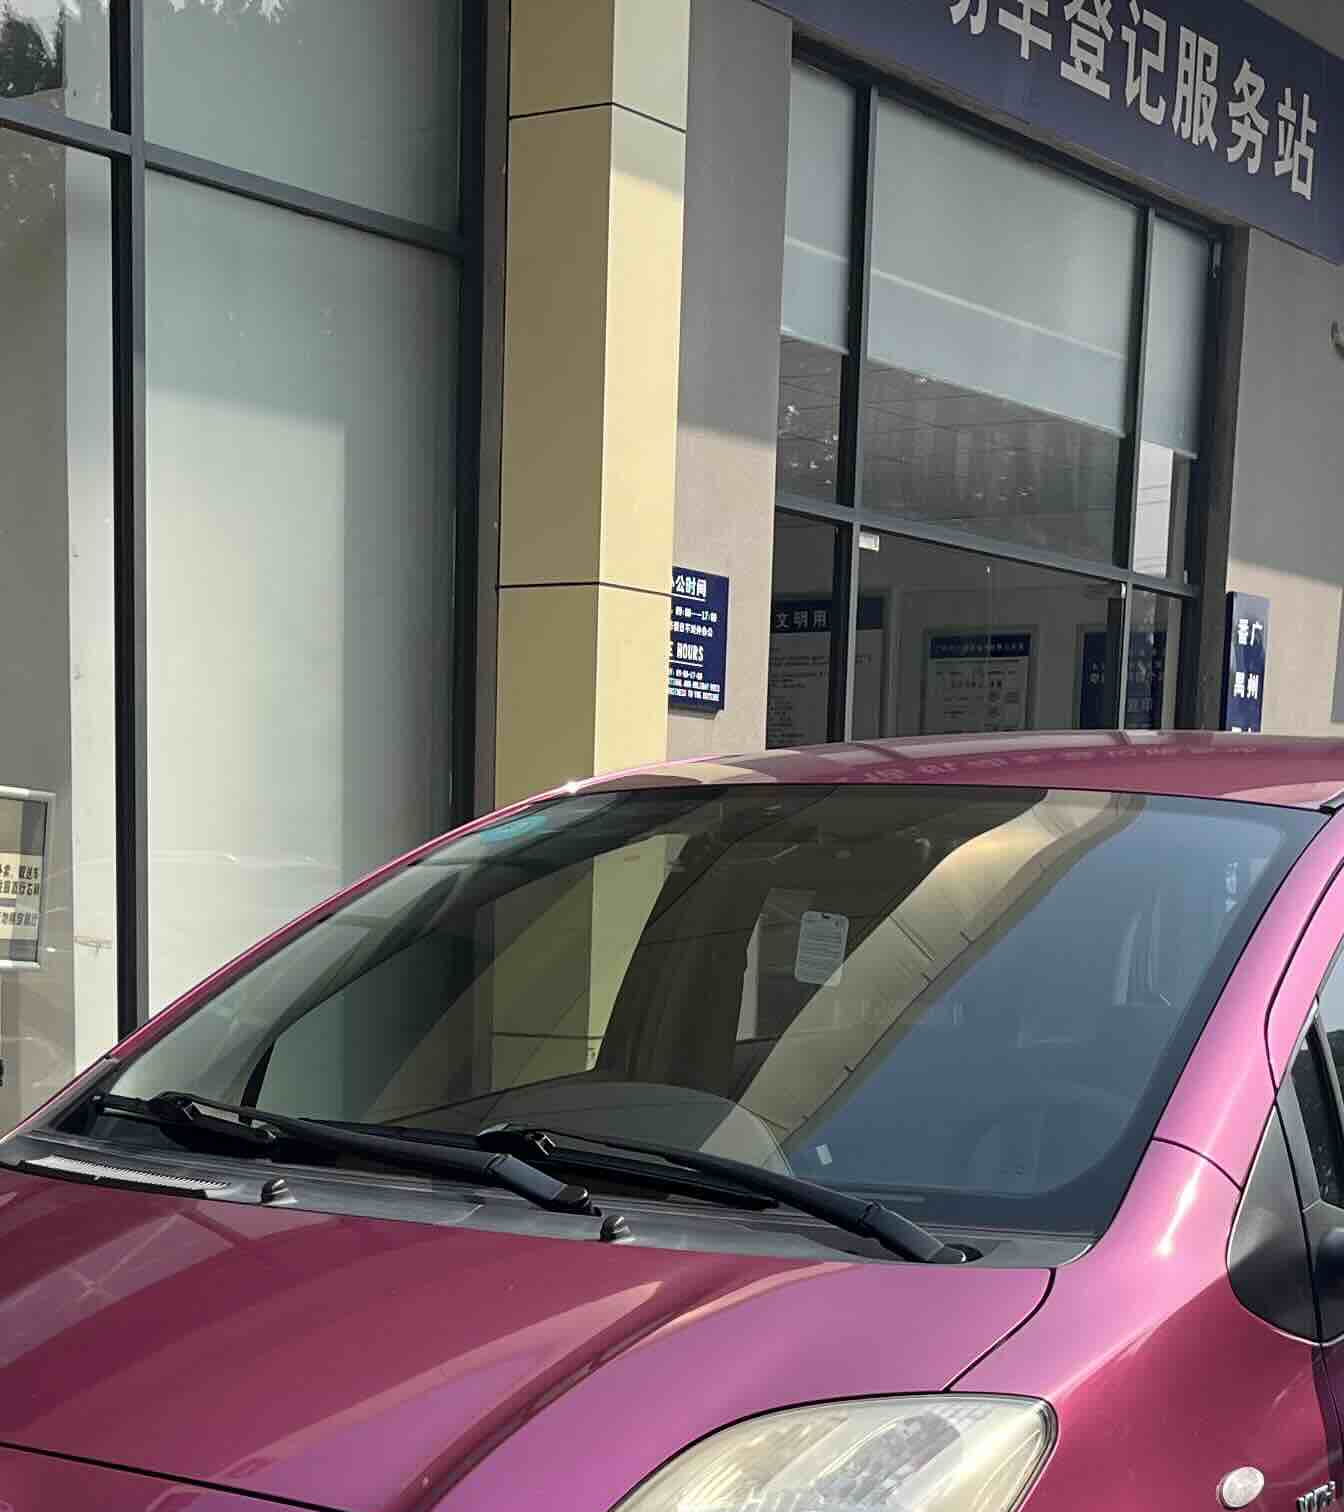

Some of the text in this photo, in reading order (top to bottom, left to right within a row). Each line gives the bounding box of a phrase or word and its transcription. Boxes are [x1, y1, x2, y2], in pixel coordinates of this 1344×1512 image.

[672, 576, 707, 597] 公时间
[676, 642, 704, 661] HOURS
